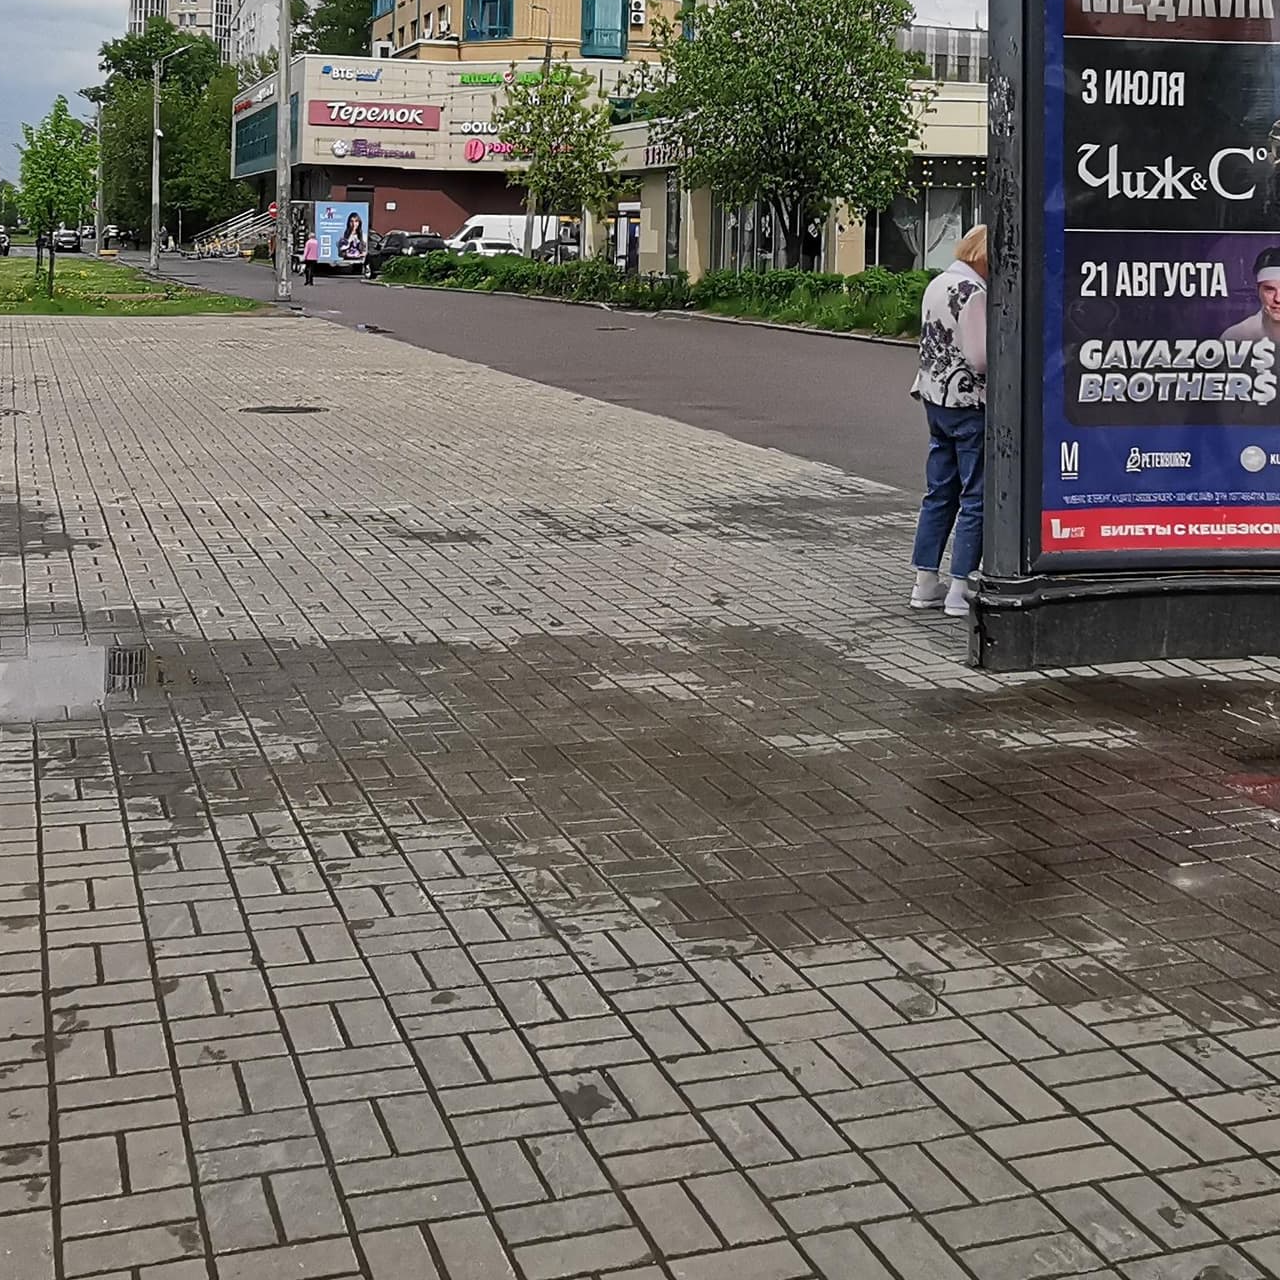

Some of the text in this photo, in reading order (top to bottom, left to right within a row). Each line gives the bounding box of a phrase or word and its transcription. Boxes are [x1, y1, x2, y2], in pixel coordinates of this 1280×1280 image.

[332, 67, 354, 79] ВТБ
[1081, 68, 1185, 107] 3 ИЮЛЯ
[326, 102, 423, 125] Теремок
[1080, 261, 1229, 298] 21 АВГУСТА
[1100, 523, 1171, 537] БИЛЕТЫ
[1173, 523, 1187, 536] С
